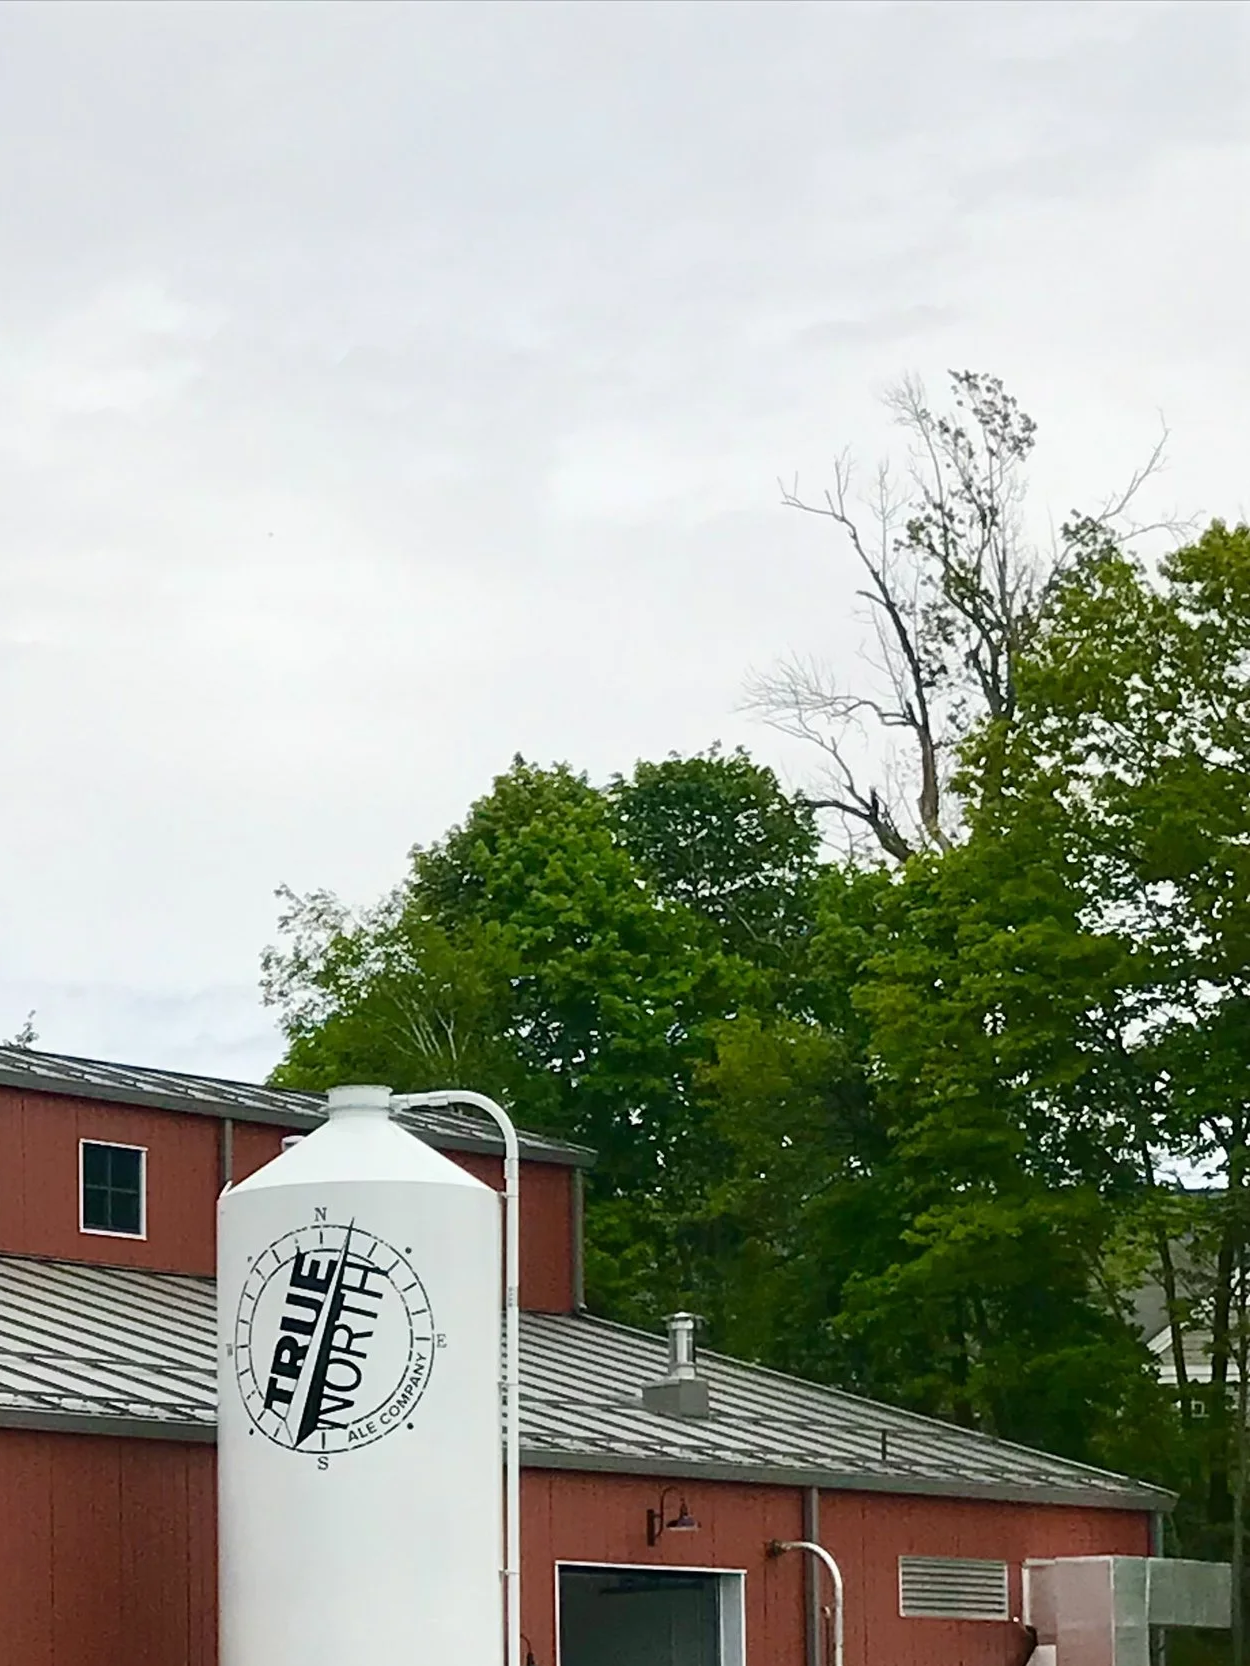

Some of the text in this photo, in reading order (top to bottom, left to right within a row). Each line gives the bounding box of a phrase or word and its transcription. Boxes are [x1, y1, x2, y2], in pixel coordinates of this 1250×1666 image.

[314, 1207, 327, 1221] N
[263, 1251, 339, 1410] TRUE
[316, 1261, 389, 1430] NORTH
[436, 1334, 447, 1348] E
[348, 1352, 427, 1443] ALE COMPANY
[317, 1456, 329, 1471] S
